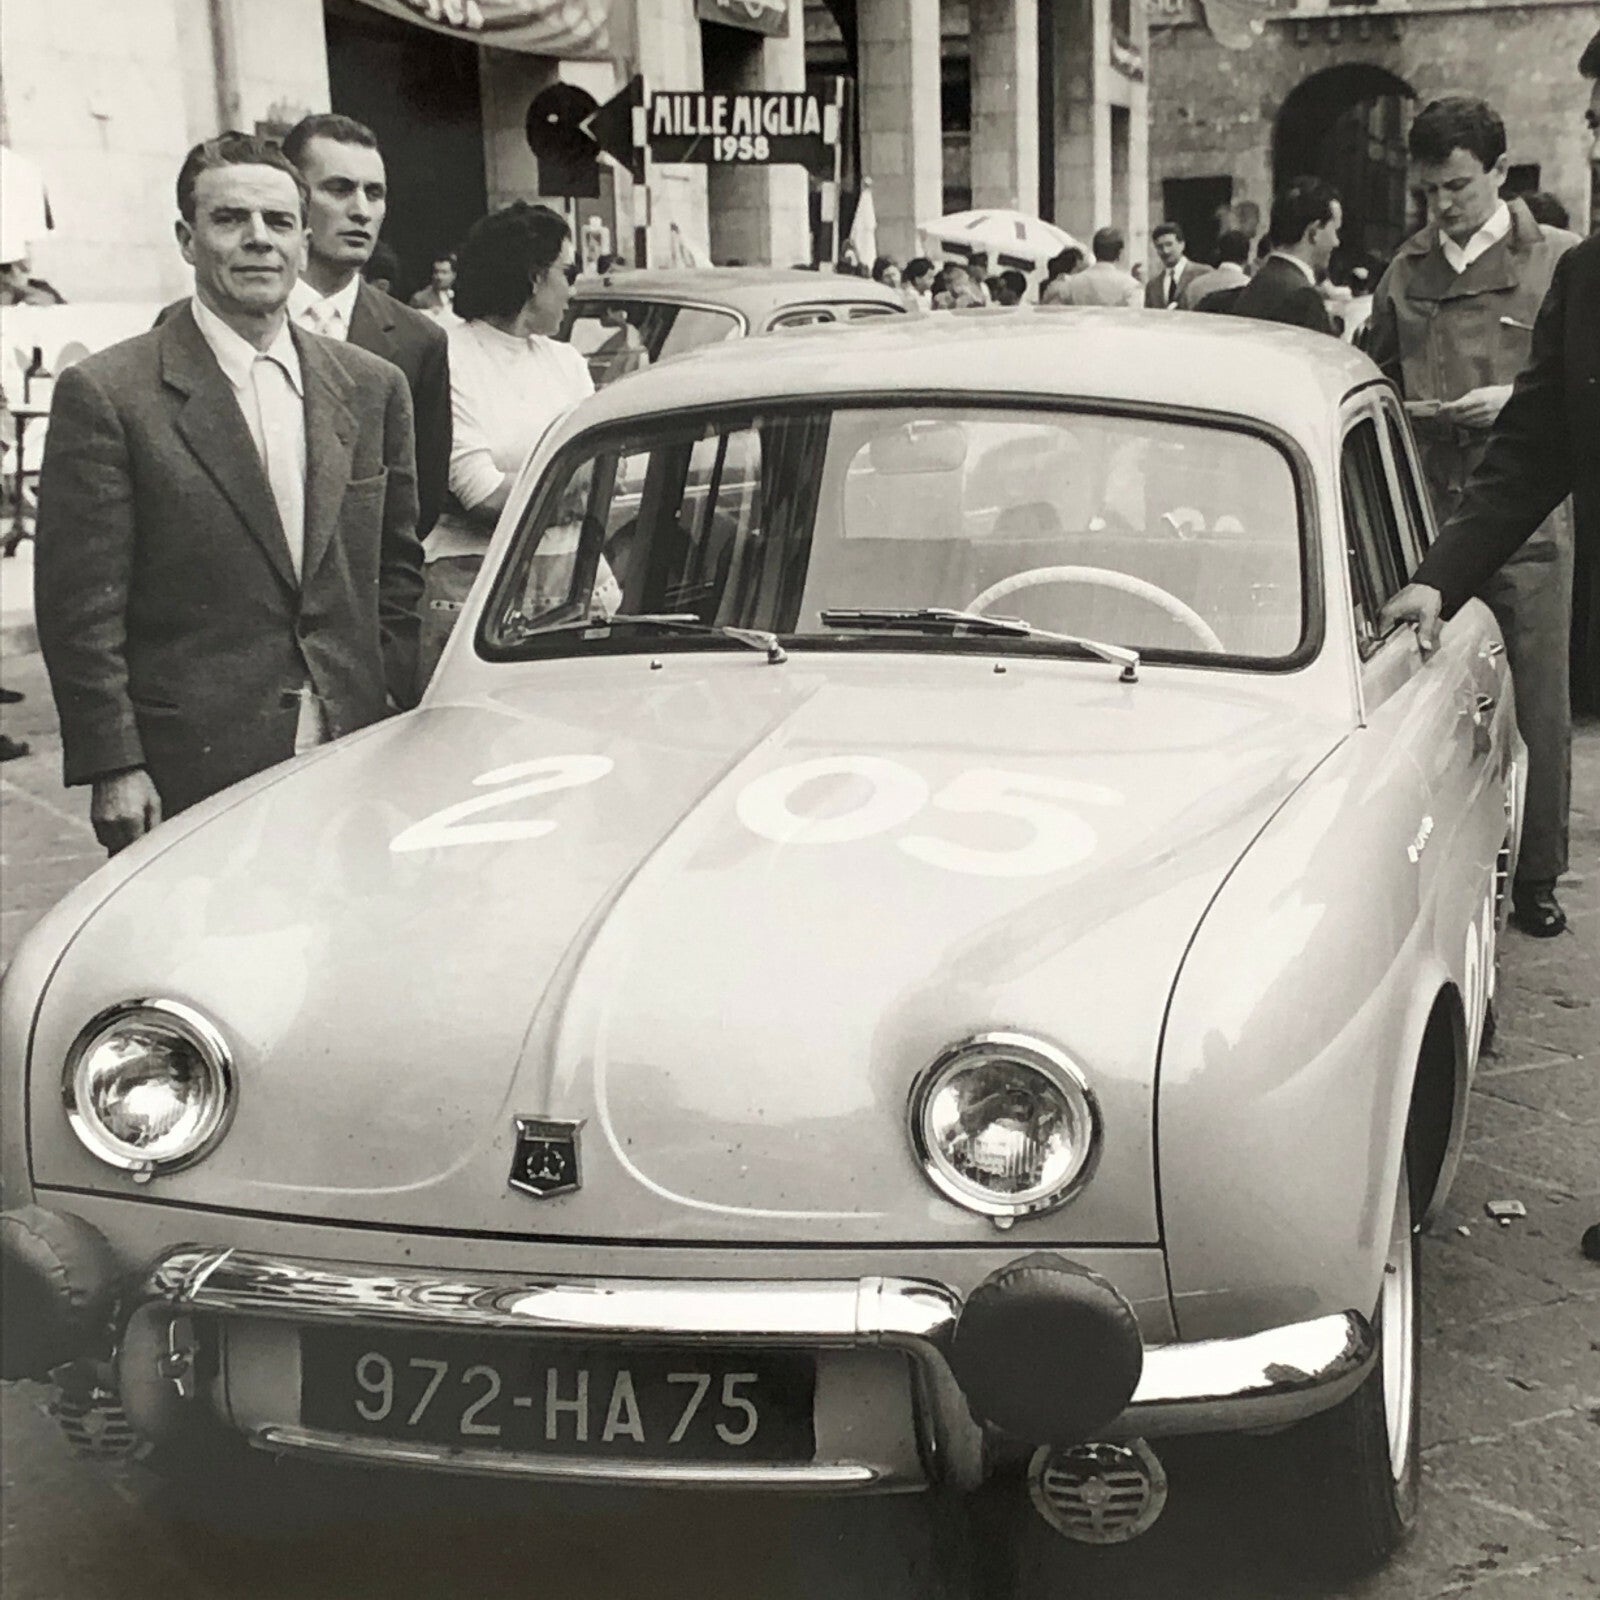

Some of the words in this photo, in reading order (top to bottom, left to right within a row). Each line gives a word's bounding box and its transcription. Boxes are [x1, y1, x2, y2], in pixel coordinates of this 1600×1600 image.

[653, 95, 728, 135] MILLE
[732, 95, 821, 136] MIGLIA
[713, 136, 770, 161] 1958
